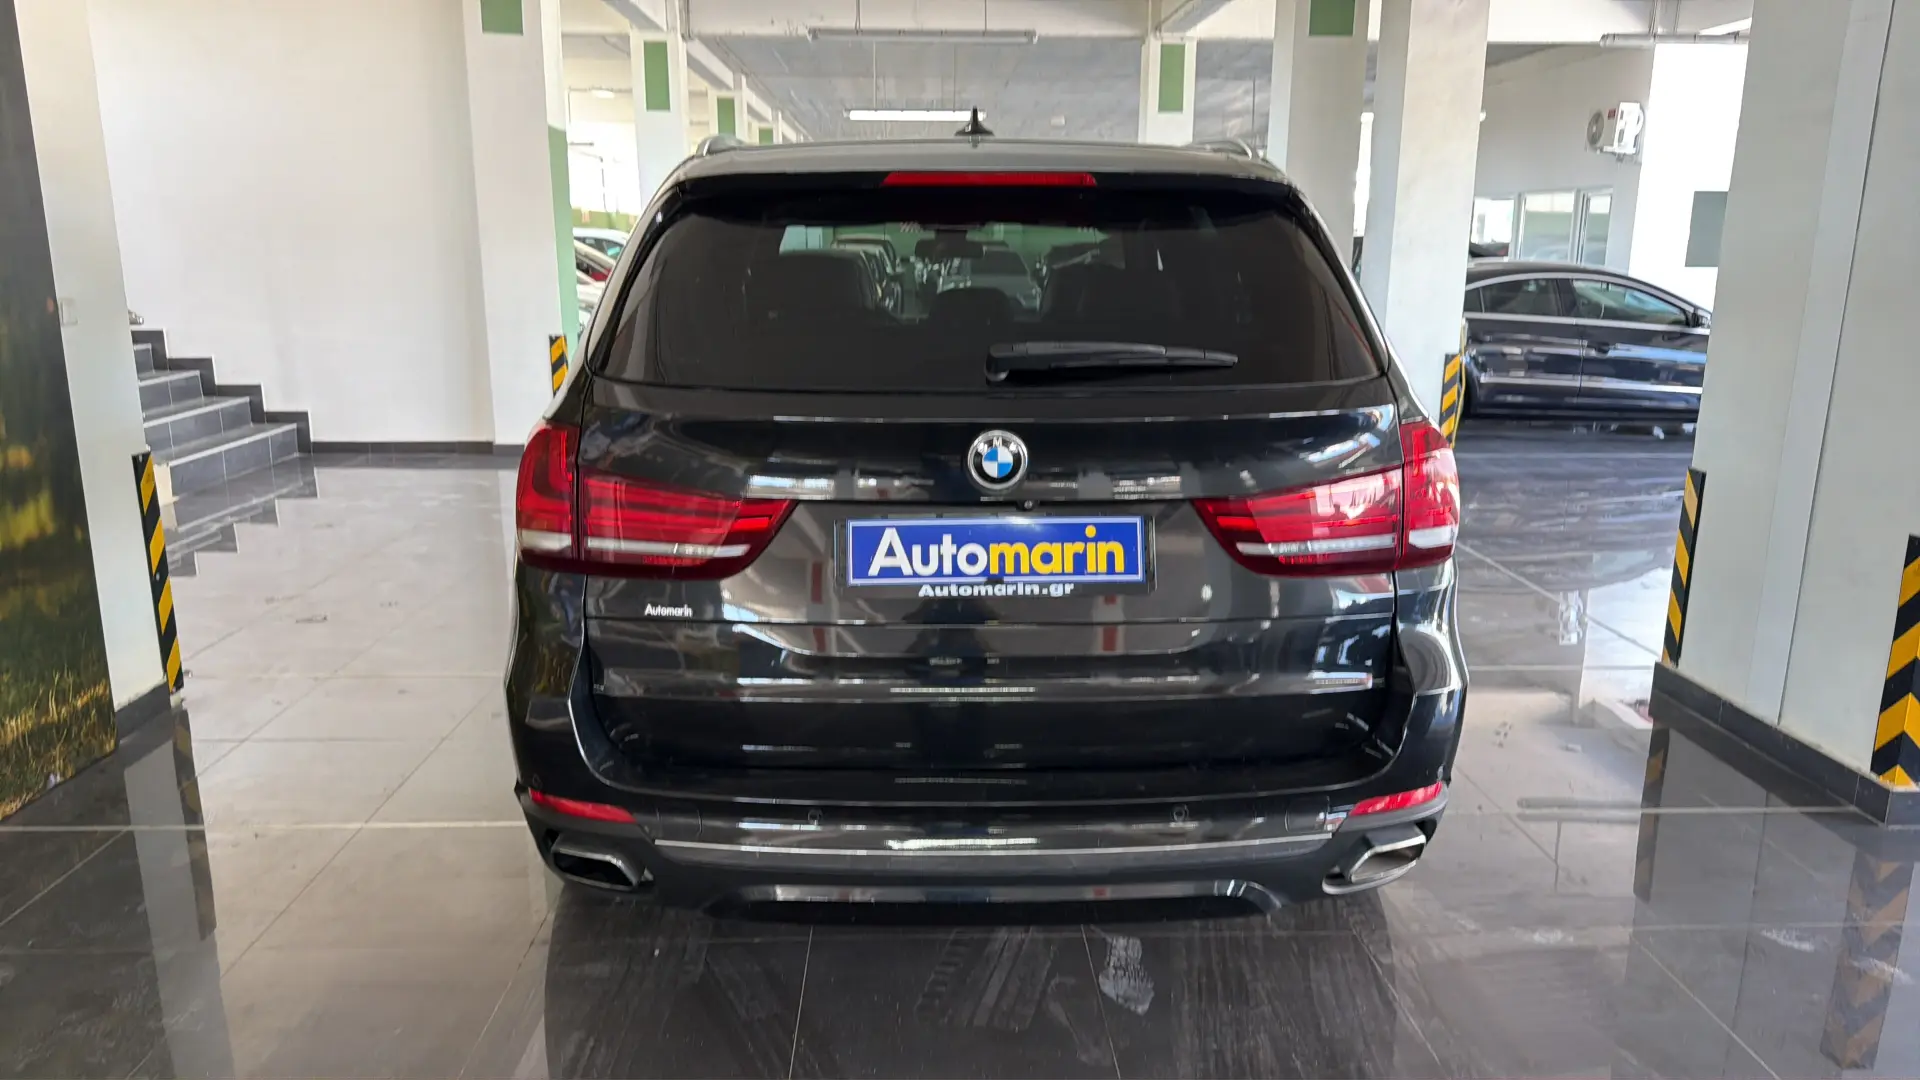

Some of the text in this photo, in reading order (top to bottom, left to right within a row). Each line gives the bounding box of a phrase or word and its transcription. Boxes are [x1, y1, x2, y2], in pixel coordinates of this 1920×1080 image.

[868, 525, 1125, 577] Automarin
[918, 582, 1074, 598] Automarin.gr
[644, 603, 693, 617] Automarin
